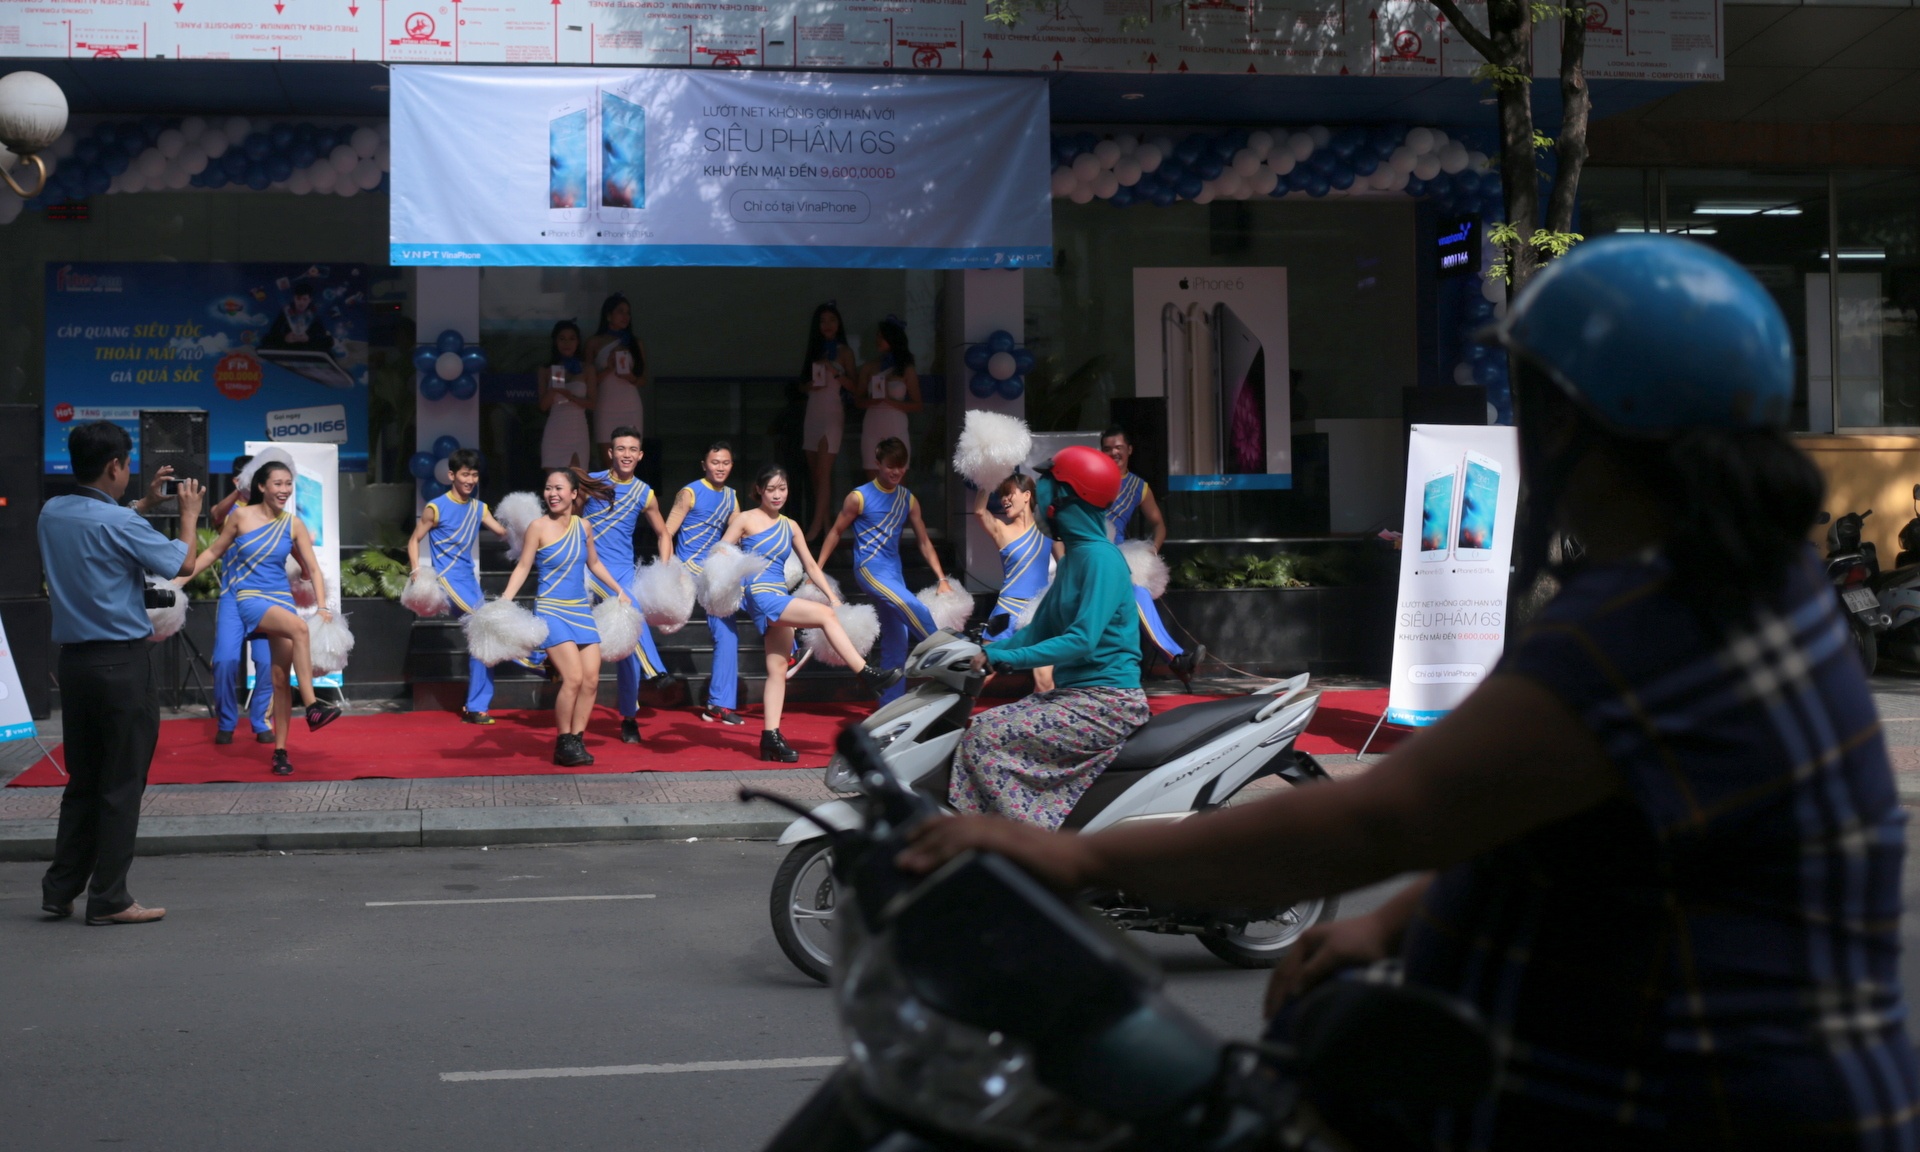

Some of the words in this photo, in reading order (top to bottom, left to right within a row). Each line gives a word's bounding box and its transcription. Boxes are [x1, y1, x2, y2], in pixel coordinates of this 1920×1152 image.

[671, 2, 717, 10] ALUMINIUM
[720, 3, 742, 11] CHEN
[744, 4, 769, 12] TRIEU
[260, 22, 307, 30] ALUMINIUM
[309, 24, 332, 32] CHEN
[334, 24, 359, 32] TRIEU
[1032, 35, 1076, 43] ALUMINIUM
[1130, 37, 1156, 45] PANEL
[1178, 45, 1203, 53] TRIEU
[1204, 46, 1224, 54] CHEN
[1226, 47, 1270, 55] ALUMINIUM
[1603, 70, 1646, 78] ALUMINIUM
[1652, 71, 1695, 79] COMPOSITE
[1697, 72, 1721, 80] PANEL
[703, 105, 738, 117] LƯỚT
[741, 106, 765, 118] NET
[768, 105, 814, 119] KHÔNG
[816, 106, 842, 120] GIỚI
[845, 108, 871, 122] HẠN
[875, 107, 896, 121] VỚI
[704, 121, 764, 153] SIÊU
[772, 121, 852, 154] PHẨM
[860, 129, 896, 154] 6S
[703, 161, 758, 177] KHUYẾN
[762, 166, 786, 180] MẠI
[789, 162, 817, 178] ĐẾN
[820, 166, 896, 180] 9,600,000Đ
[743, 199, 763, 212] Chỉ
[765, 200, 779, 212] có
[782, 200, 795, 214] tại
[797, 200, 857, 213] VinaPhone
[547, 230, 570, 238] iPhone
[603, 230, 624, 238] iPhone
[401, 250, 440, 259] VNPT
[441, 250, 481, 260] VinaPhone
[1007, 254, 1042, 262] VNPT
[1192, 276, 1234, 290] iPhone
[1236, 277, 1245, 290] 6
[85, 326, 130, 340] QUANG
[133, 321, 170, 338] SIÊU
[178, 344, 204, 360] ALÔ
[110, 368, 133, 382] GIÁ
[55, 407, 73, 418] Hot
[1422, 600, 1434, 608] NET
[1435, 599, 1458, 607] KHÔNG
[1400, 610, 1432, 628] SIÊU
[1435, 607, 1477, 627] PHẨM
[1481, 611, 1501, 627] 6S
[1443, 670, 1478, 678] VinaPhone
[12, 727, 32, 735] VNPT
